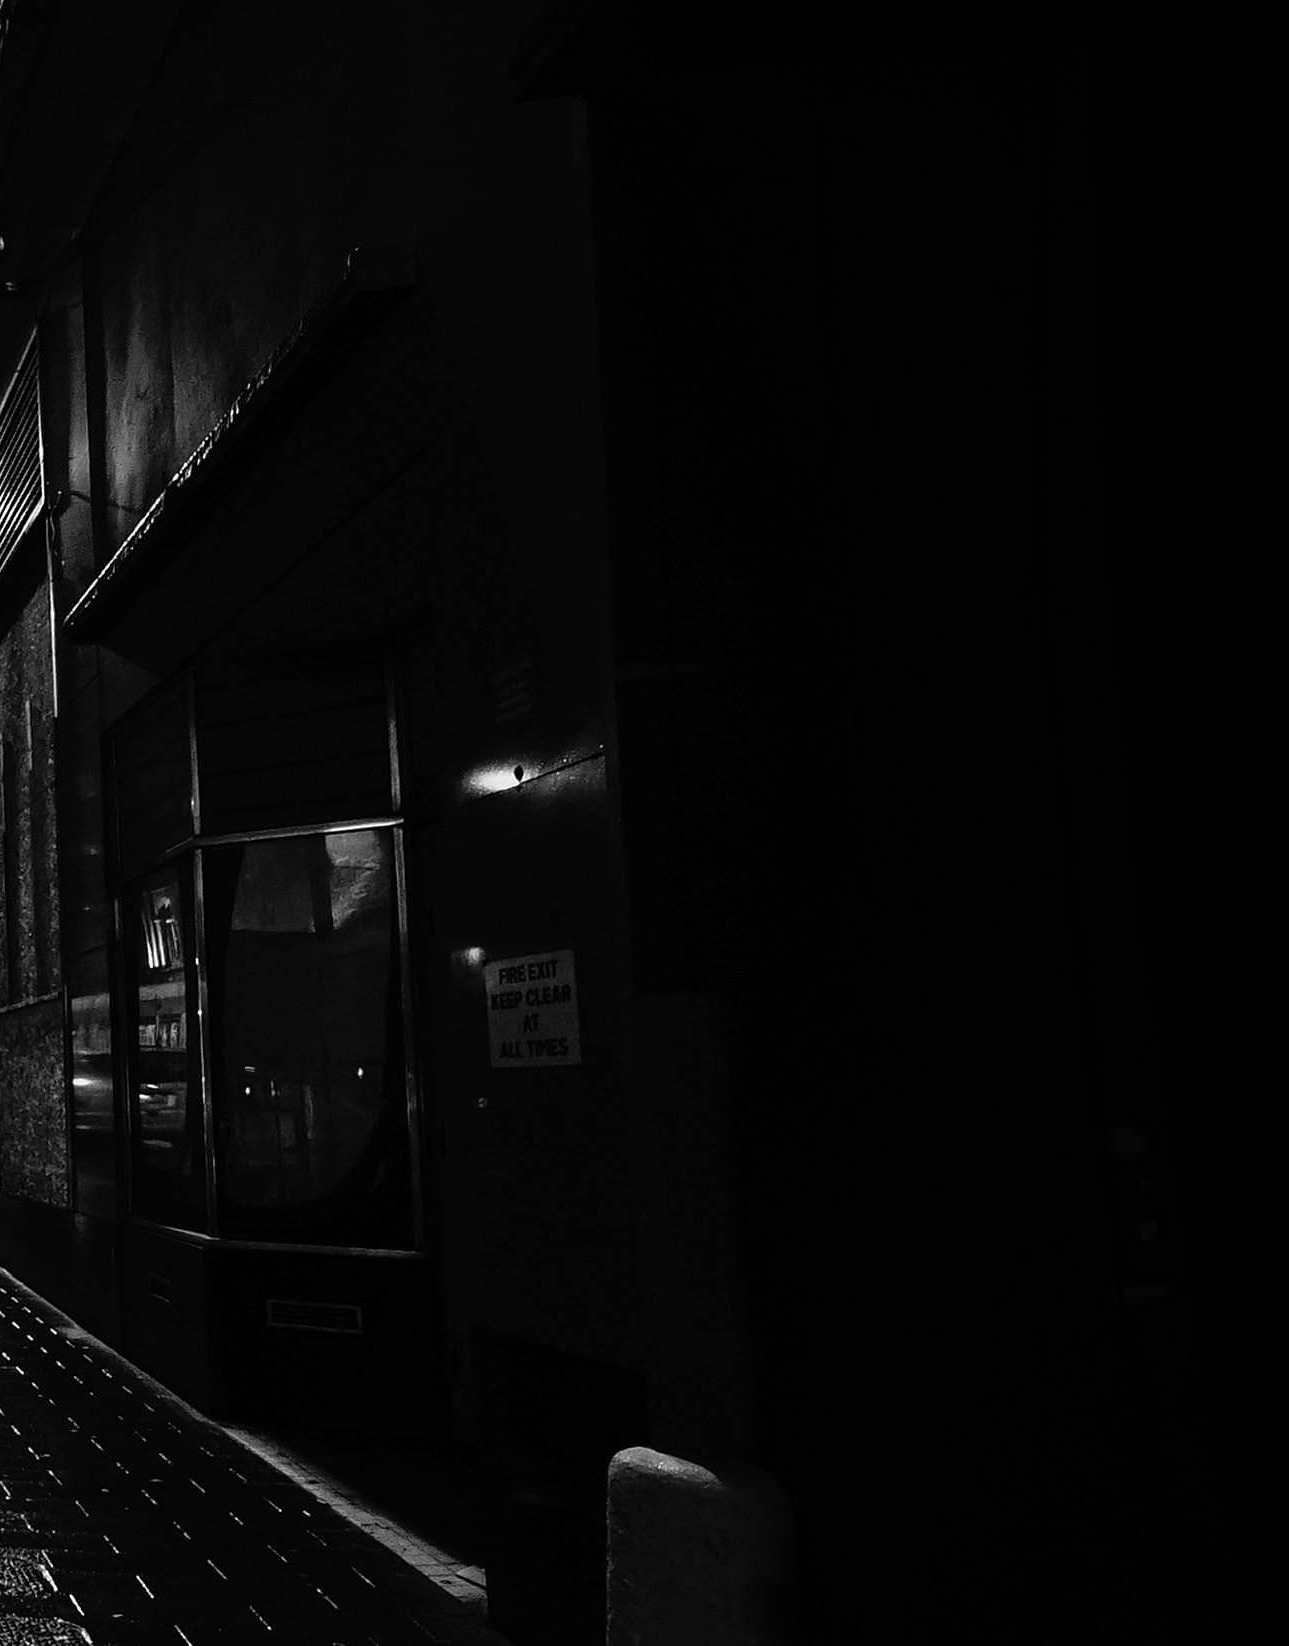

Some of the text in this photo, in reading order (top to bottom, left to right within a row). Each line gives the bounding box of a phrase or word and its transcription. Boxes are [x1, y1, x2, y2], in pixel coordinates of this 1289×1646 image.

[499, 960, 558, 984] FIRE EXIT
[491, 984, 572, 1010] KEEP CLEAR
[523, 1013, 539, 1032] AT
[500, 1038, 569, 1058] ALL TIMES
